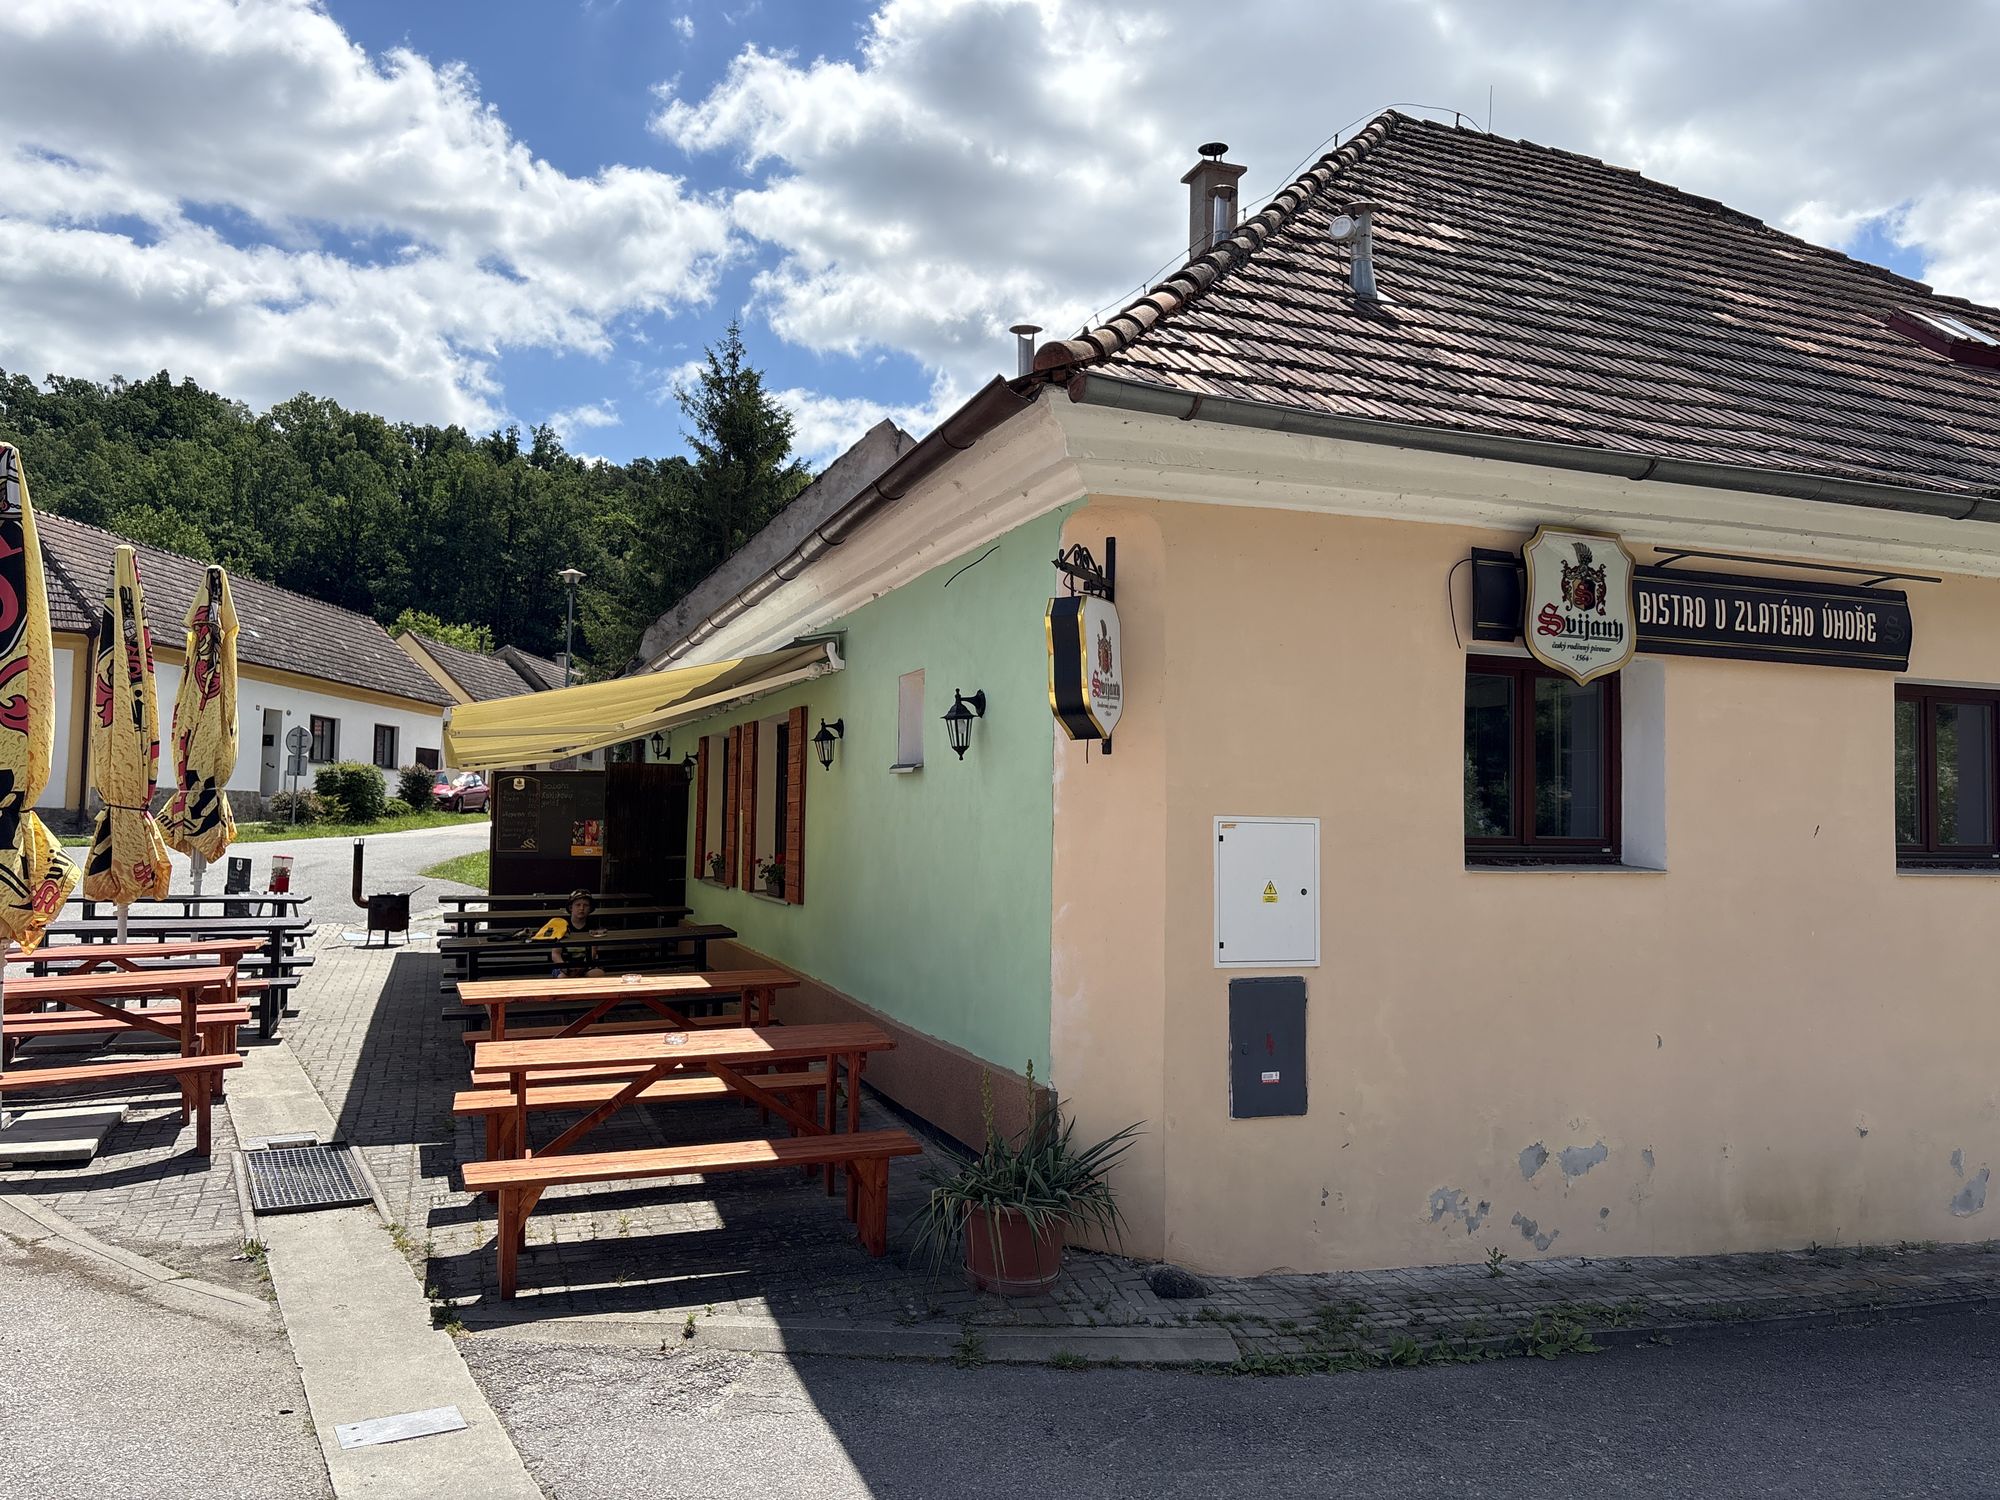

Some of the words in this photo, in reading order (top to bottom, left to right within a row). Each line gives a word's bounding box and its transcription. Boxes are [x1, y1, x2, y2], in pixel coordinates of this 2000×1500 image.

[1537, 602, 1624, 645] Svijany
[1638, 591, 1706, 628] BISTRO
[1714, 599, 1726, 630] U
[1734, 598, 1814, 637] ZLATÉHO
[1822, 602, 1877, 643] ÚHOŘE
